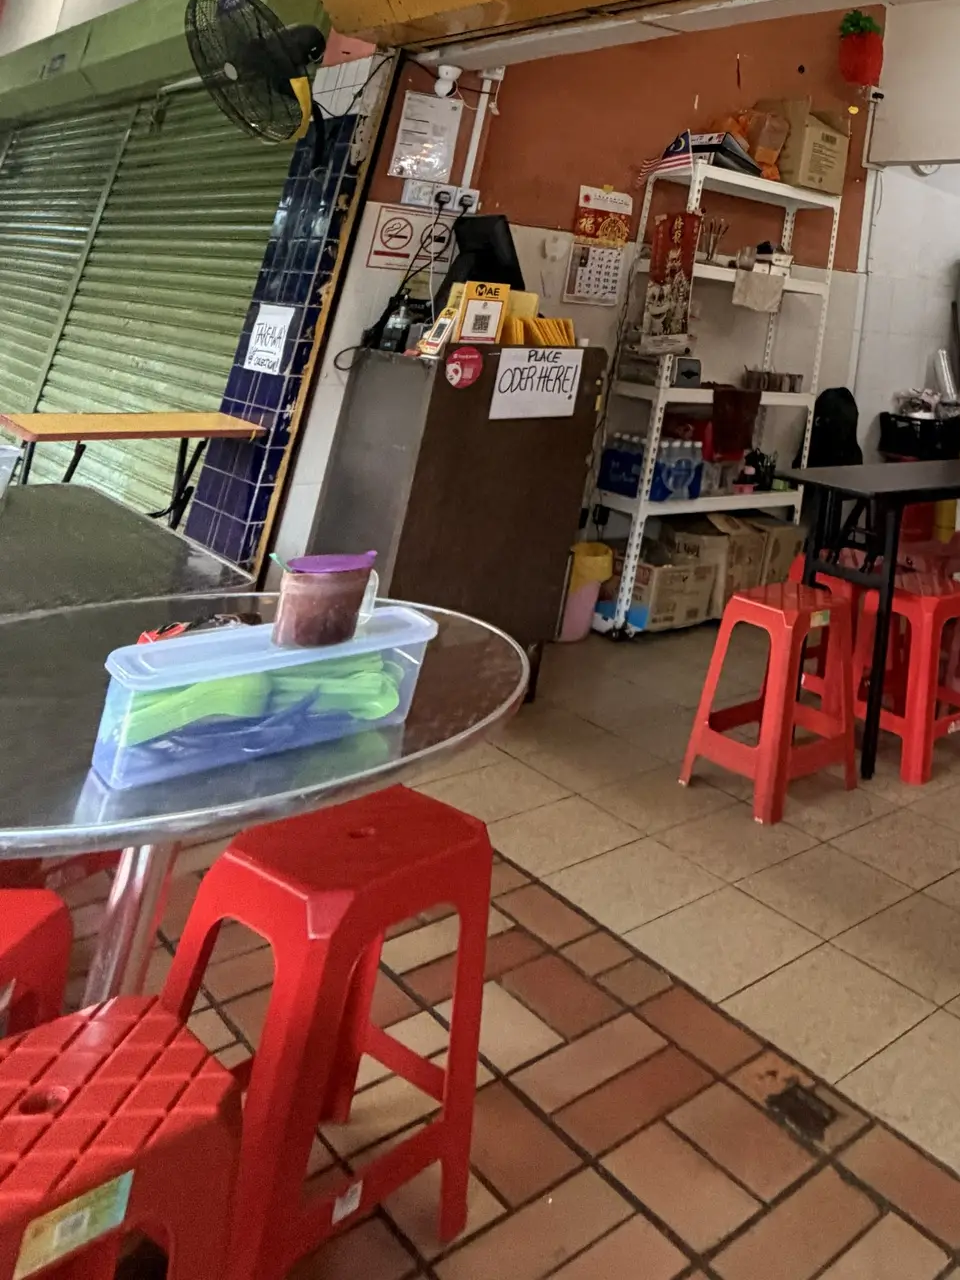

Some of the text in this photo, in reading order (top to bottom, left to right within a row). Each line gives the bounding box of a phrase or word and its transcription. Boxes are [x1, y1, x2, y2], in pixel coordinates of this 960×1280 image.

[475, 283, 500, 297] MAE
[527, 349, 562, 363] PLACE
[498, 365, 578, 401] ODER HERE!
